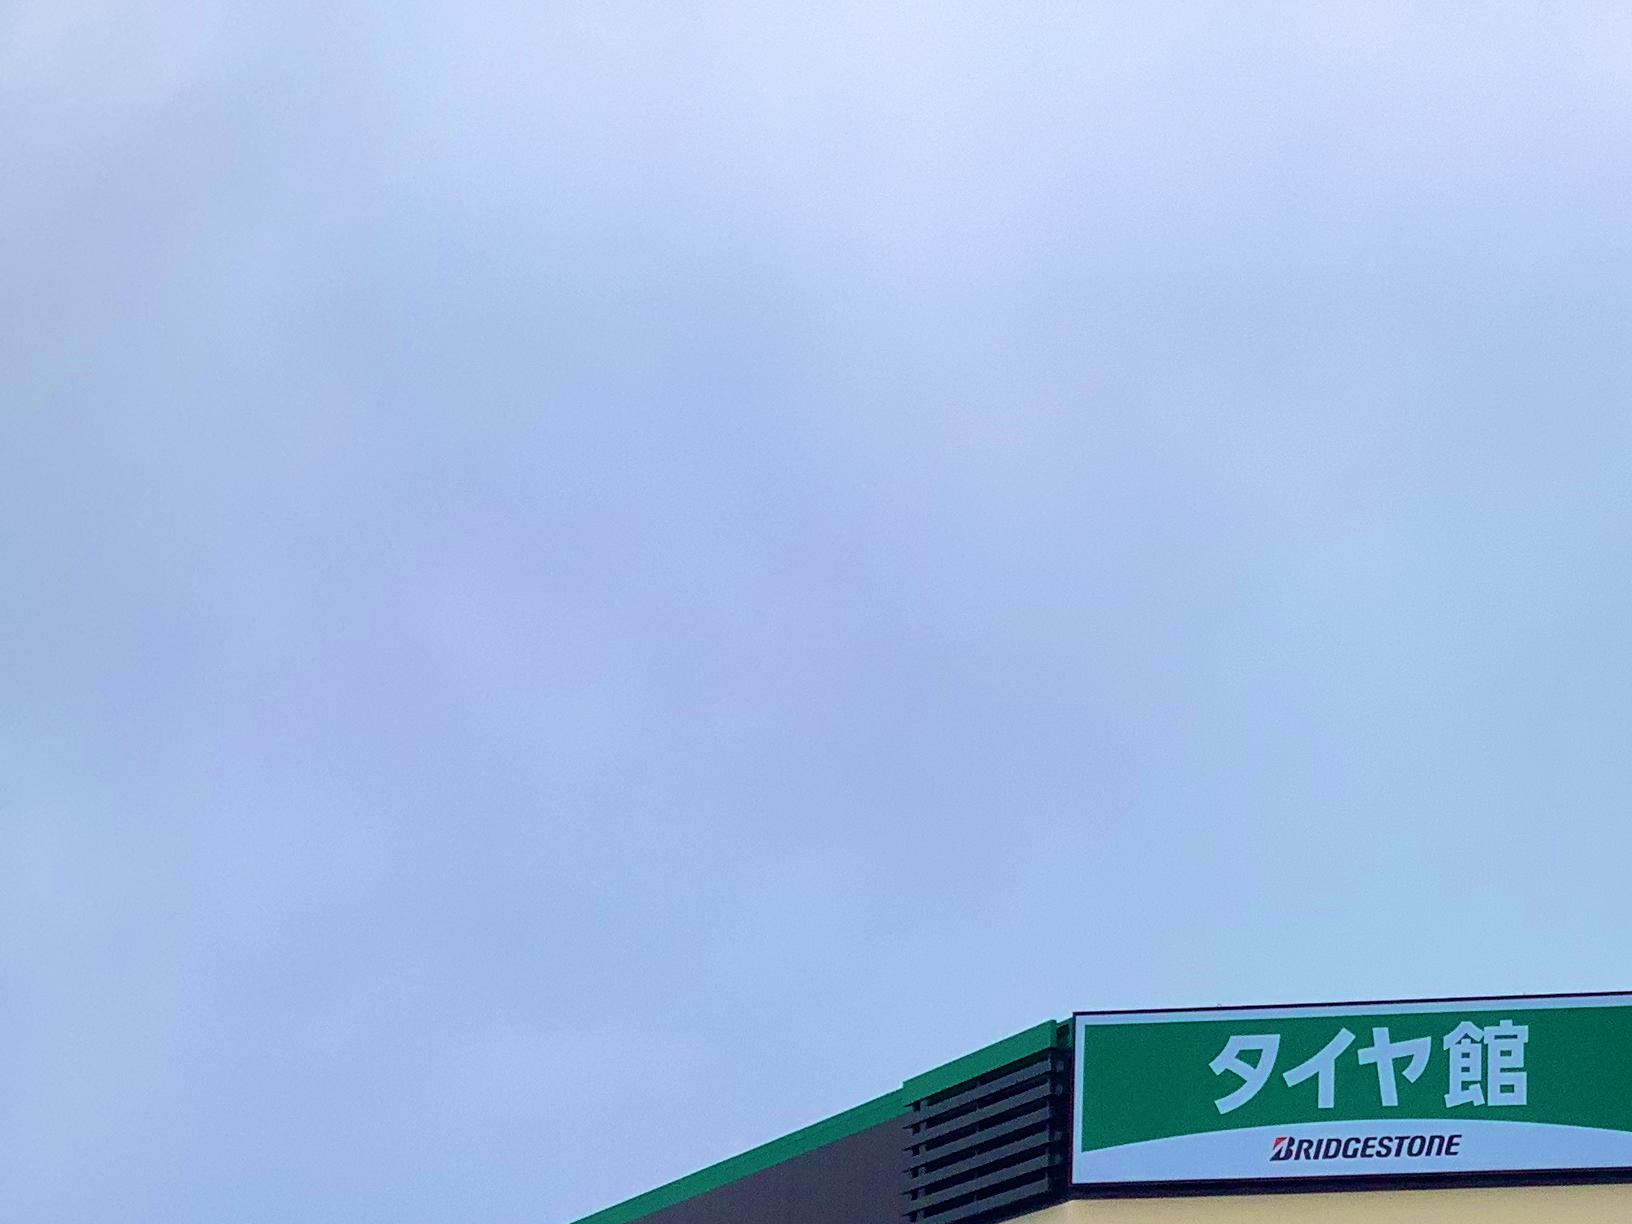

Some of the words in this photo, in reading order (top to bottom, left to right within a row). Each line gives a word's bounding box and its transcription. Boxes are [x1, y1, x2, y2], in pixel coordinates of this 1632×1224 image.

[1209, 1020, 1529, 1114] タイヤ館
[1269, 1134, 1462, 1162] BRIDGESTONE
